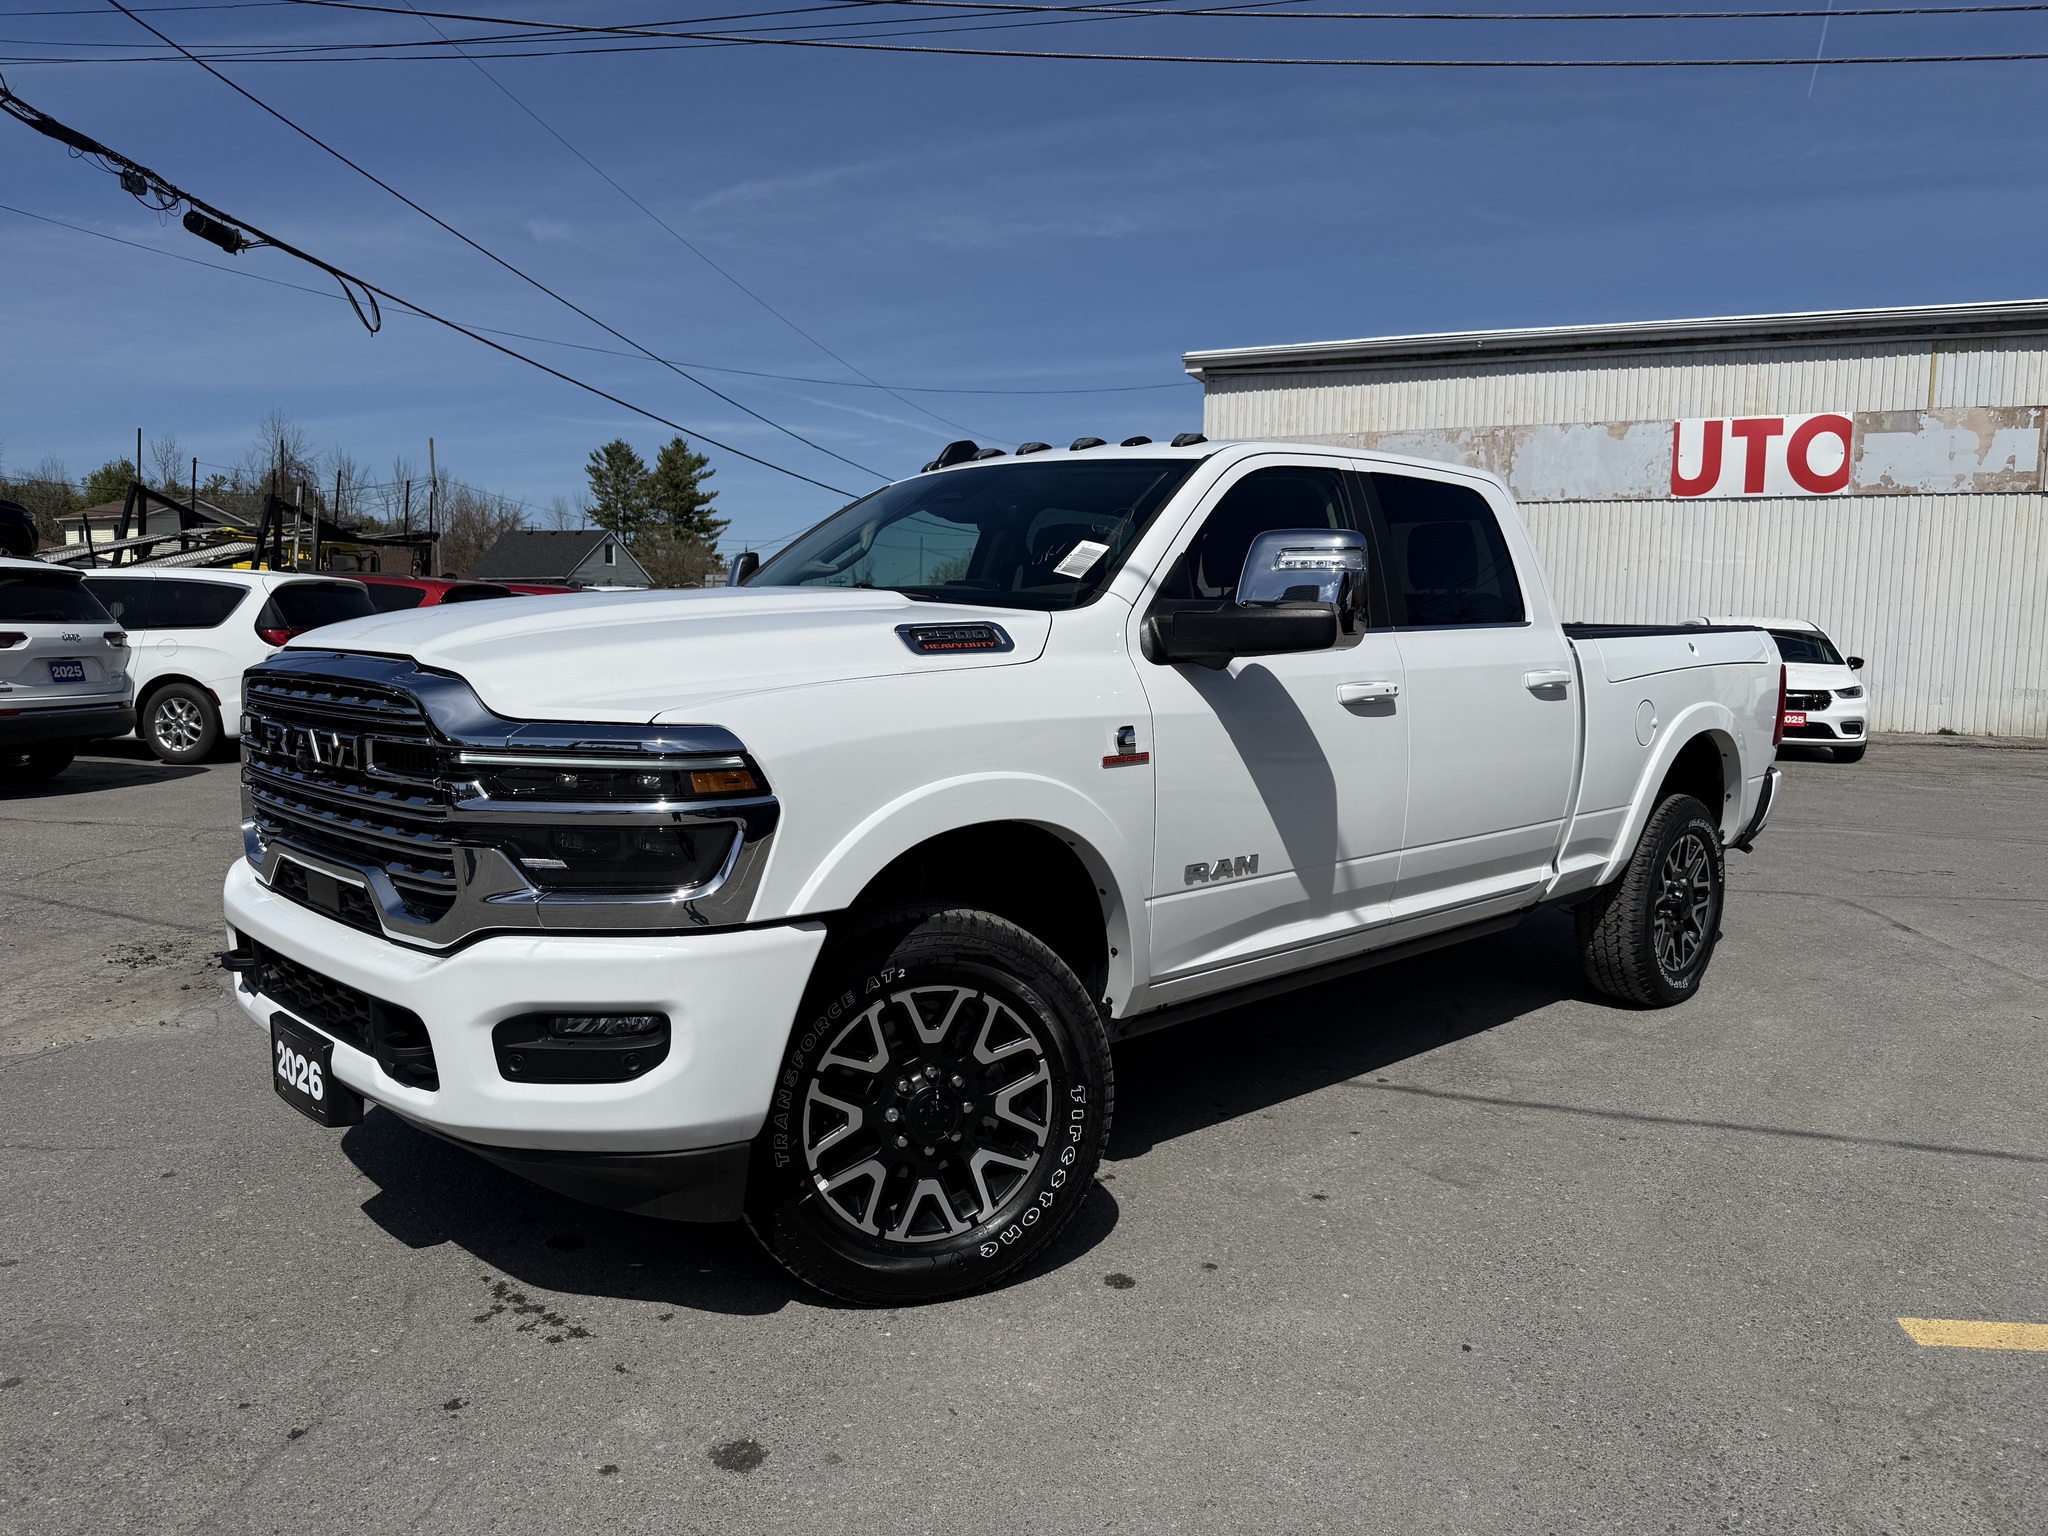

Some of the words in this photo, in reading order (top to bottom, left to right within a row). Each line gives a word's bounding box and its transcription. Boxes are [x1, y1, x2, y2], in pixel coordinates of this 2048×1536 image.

[1671, 414, 1853, 497] UTO
[52, 666, 83, 678] 2025
[1784, 715, 1805, 724] 025
[1184, 854, 1259, 886] RAM
[277, 1040, 324, 1101] 2026
[774, 990, 857, 1168] TRANSFORCE
